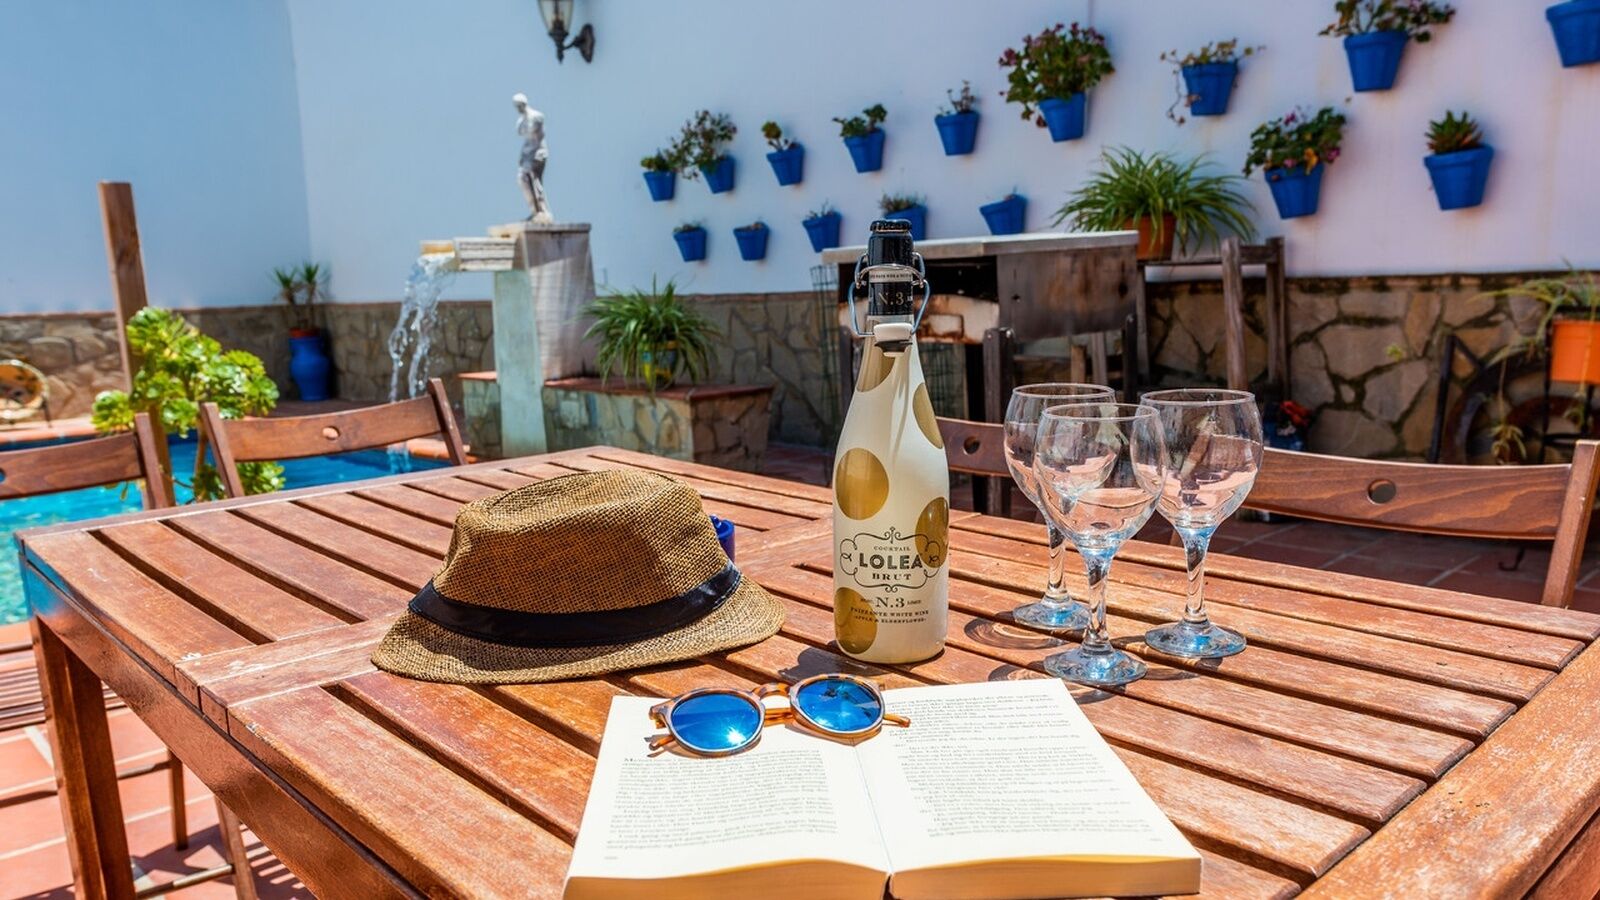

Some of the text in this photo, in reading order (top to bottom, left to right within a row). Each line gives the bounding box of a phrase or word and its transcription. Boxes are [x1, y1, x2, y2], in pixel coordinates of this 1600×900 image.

[859, 553, 923, 570] LOLEA
[872, 573, 912, 581] BRUT
[875, 596, 905, 608] N.3
